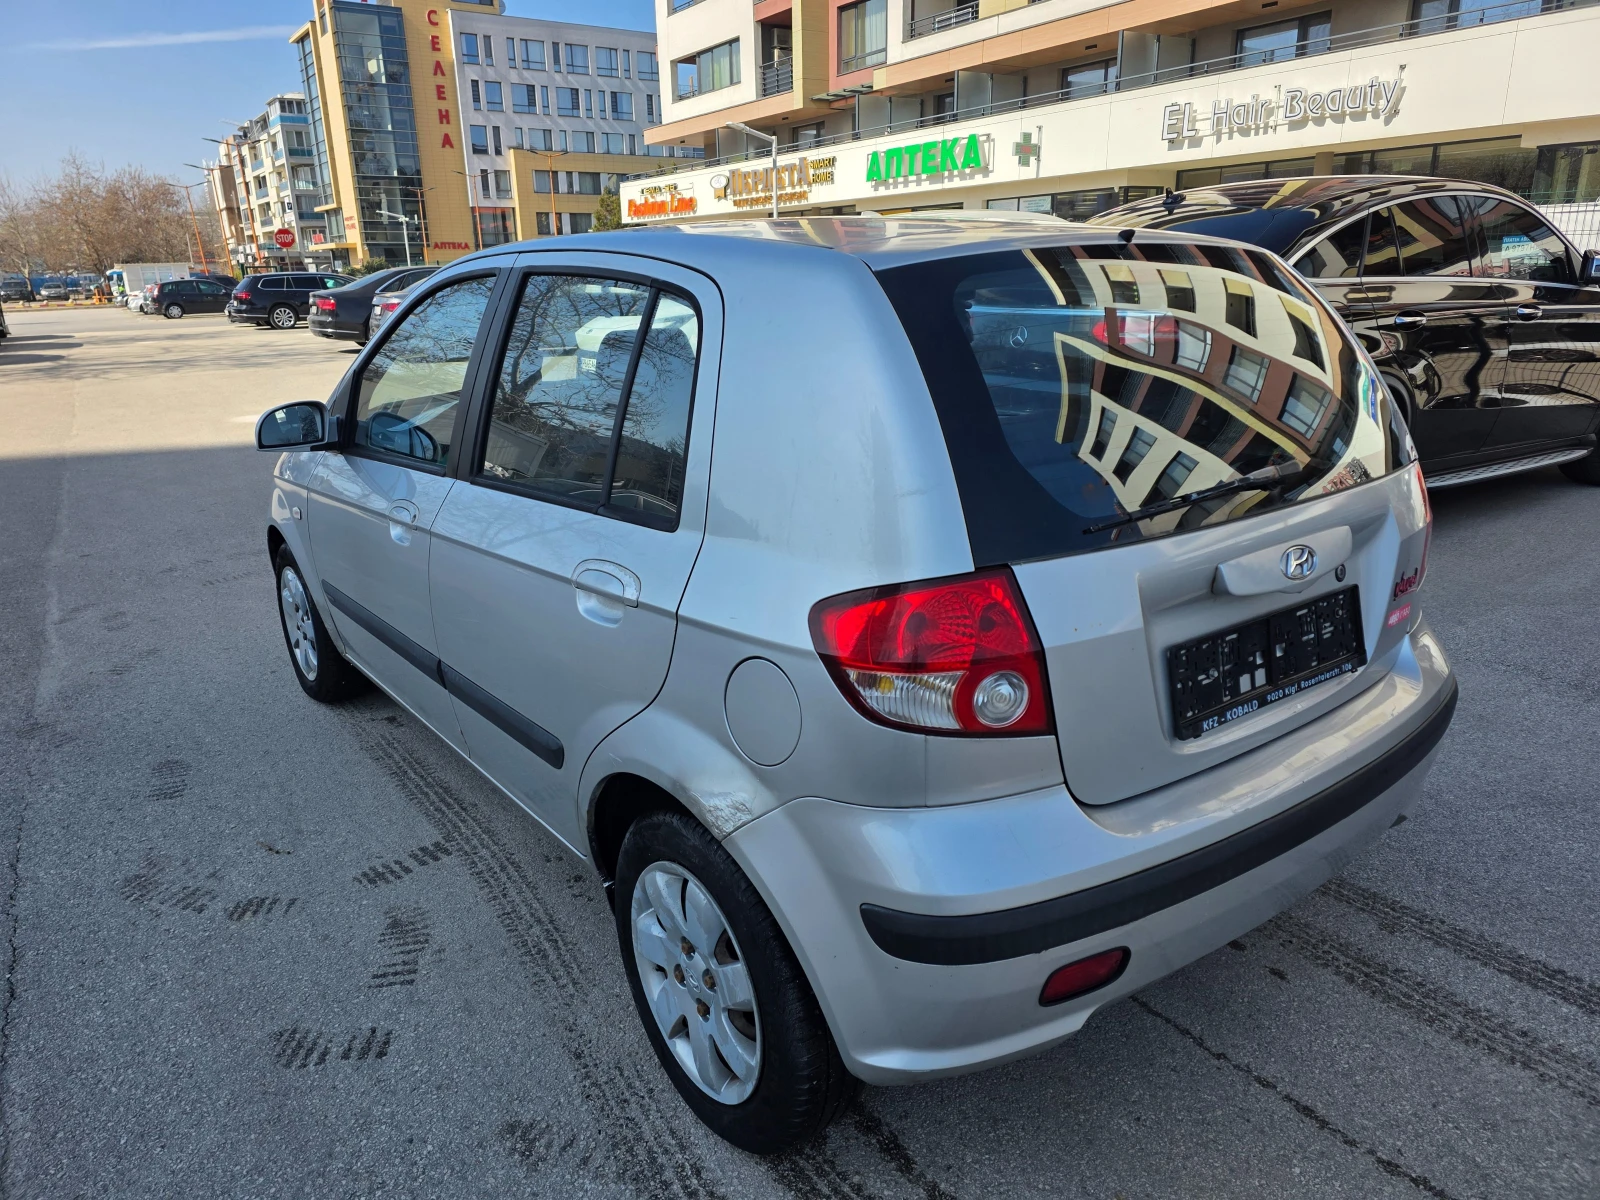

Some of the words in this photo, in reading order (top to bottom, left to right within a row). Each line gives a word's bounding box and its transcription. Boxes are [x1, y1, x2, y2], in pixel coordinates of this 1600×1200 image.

[426, 9, 454, 149] СЕЛЕНА
[1161, 102, 1197, 140] EL
[1210, 94, 1271, 133] Hair
[1283, 77, 1401, 120] Beauty
[809, 156, 836, 169] SMART
[866, 134, 982, 182] АПТЕКА
[812, 171, 833, 184] HOME
[276, 234, 293, 243] STOP
[433, 241, 470, 250] АПТЕКА
[1203, 716, 1219, 731] KFZ
[1226, 700, 1259, 721] KOBALD
[1267, 689, 1284, 702] 9020
[1342, 662, 1352, 671] 106
